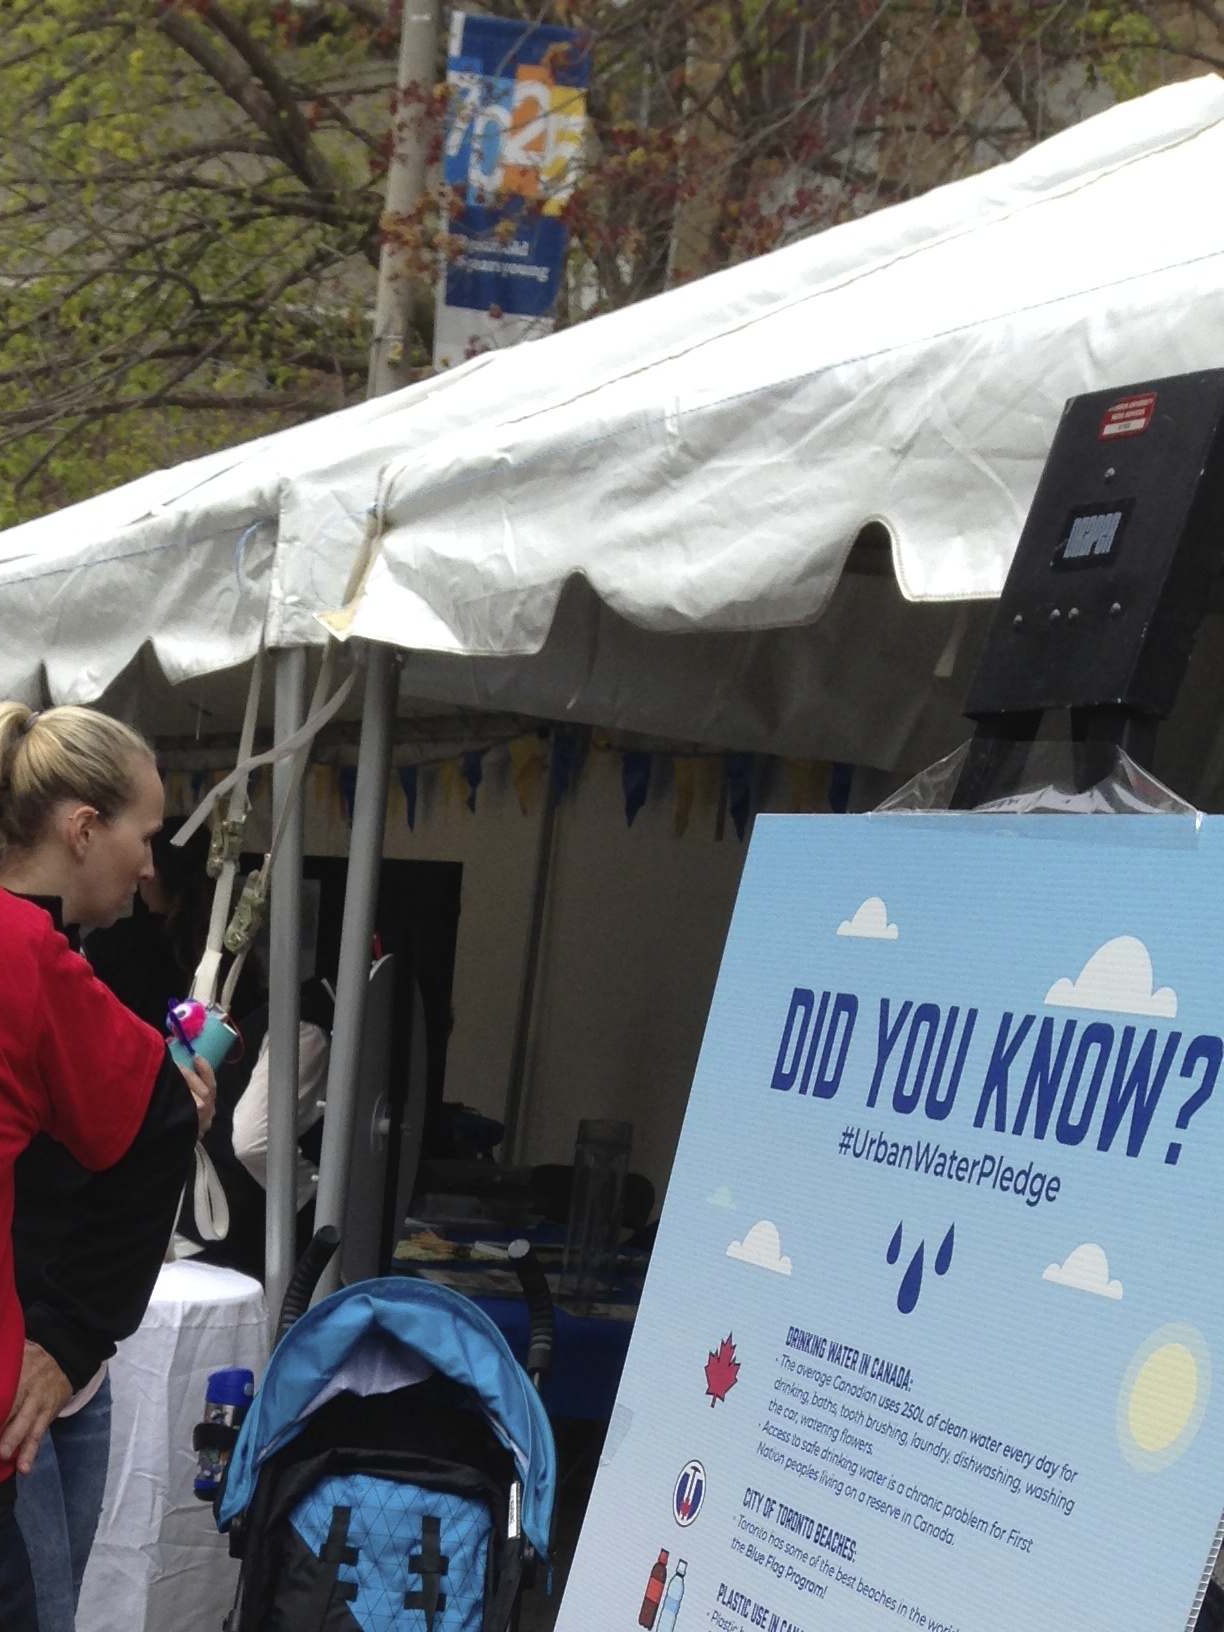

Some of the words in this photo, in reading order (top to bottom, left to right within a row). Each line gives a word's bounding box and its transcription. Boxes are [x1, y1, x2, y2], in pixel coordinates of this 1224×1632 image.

[769, 986, 859, 1100] DID
[865, 996, 978, 1121] YOU
[972, 1010, 1223, 1165] KNOW?
[837, 1125, 1061, 1207] #UrbanWaterPledge
[784, 1325, 827, 1359] DRINKING
[826, 1340, 860, 1371] WATER
[869, 1356, 913, 1392] CANADA:
[773, 1376, 809, 1405] drinking,
[810, 1390, 837, 1417] baths,
[839, 1403, 865, 1426] tooth
[864, 1413, 909, 1447] brushing,
[952, 1450, 1022, 1494] dishwashing,
[1024, 1481, 1075, 1516] washing
[795, 1363, 832, 1388] average
[831, 1374, 877, 1404] Canadian
[877, 1395, 901, 1414] uses
[899, 1400, 925, 1424] 250L
[937, 1416, 968, 1440] clean
[968, 1430, 1003, 1453] water
[1001, 1443, 1036, 1470] every
[1034, 1454, 1060, 1479] day
[799, 1414, 840, 1443] watering
[742, 1486, 765, 1513] CITY
[775, 1502, 815, 1540] TORONTO
[812, 1521, 857, 1563] BEACHES:
[760, 1419, 791, 1443] Access
[819, 1445, 859, 1477] drinking
[858, 1465, 888, 1486] water
[904, 1484, 944, 1512] chronic
[940, 1503, 989, 1533] problem
[988, 1519, 1007, 1540] for
[1005, 1527, 1034, 1553] First
[783, 1456, 820, 1481] peoples
[818, 1469, 845, 1496] living
[865, 1494, 901, 1520] reserve
[912, 1513, 954, 1546] Canada.
[715, 1581, 752, 1618] PLASTIC
[749, 1602, 770, 1630] USE
[736, 1512, 768, 1541] Toronto
[766, 1529, 785, 1550] has
[783, 1542, 809, 1563] some
[834, 1565, 857, 1589] best
[855, 1576, 897, 1611] beaches
[907, 1606, 927, 1627] the
[744, 1542, 765, 1565] Blue
[764, 1553, 785, 1579] Flag
[783, 1564, 828, 1599] Program!
